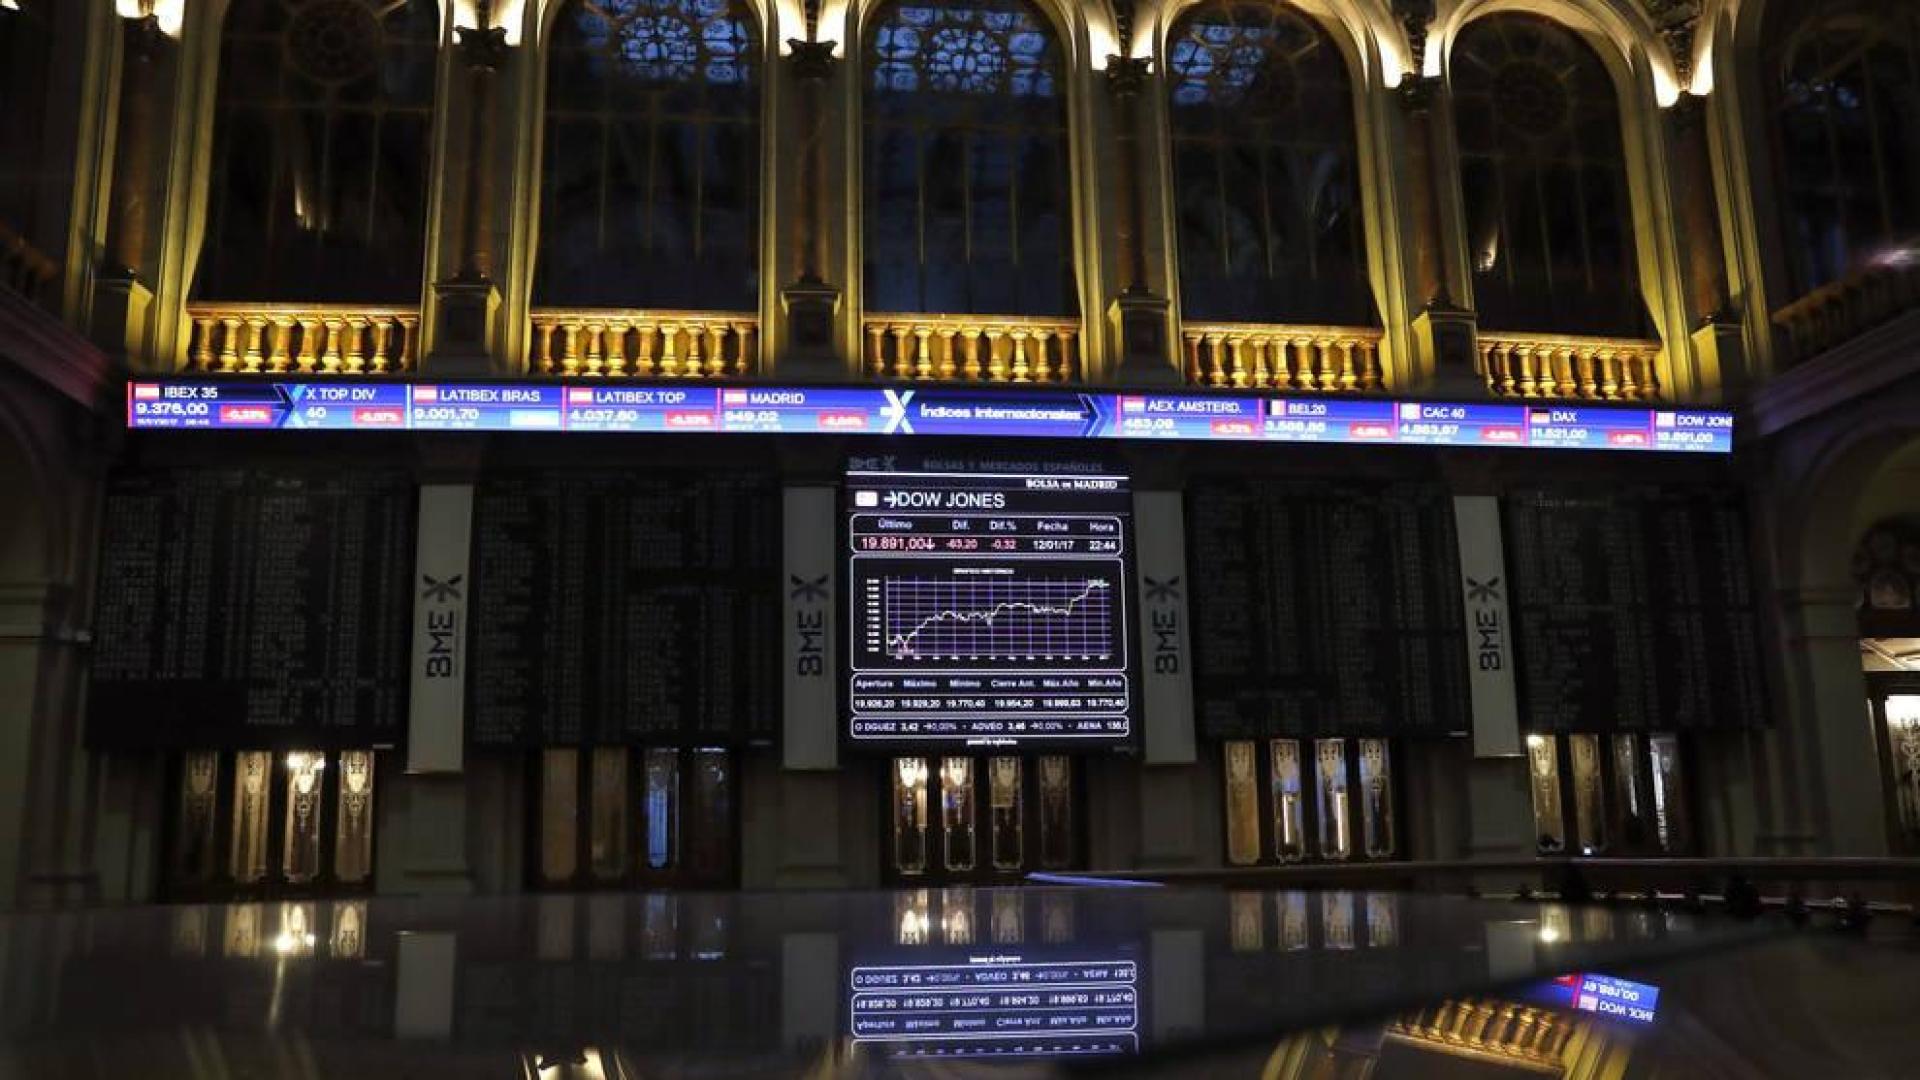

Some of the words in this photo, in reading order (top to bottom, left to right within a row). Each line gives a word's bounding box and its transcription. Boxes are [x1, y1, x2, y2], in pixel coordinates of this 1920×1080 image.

[165, 387, 199, 399] IBEX
[201, 387, 218, 399] 35
[306, 388, 318, 400] X
[320, 388, 350, 400] TOP
[352, 388, 377, 400] DIV
[441, 390, 500, 402] LATIBEX
[502, 391, 541, 402] BRAS
[596, 391, 654, 404] LATIBEX
[656, 392, 686, 404] TOP
[750, 393, 805, 404] MADRID
[1148, 400, 1175, 412] AEX
[306, 407, 327, 418] 40
[1423, 407, 1449, 418] CAC
[1450, 408, 1465, 418] 40
[1552, 412, 1577, 423] DAX
[1677, 415, 1706, 426] DOW
[1025, 479, 1060, 489] BOLSA
[1074, 480, 1118, 489] MADRID
[898, 491, 942, 508] DOW
[946, 491, 1006, 509] JONES
[1037, 521, 1069, 532] Fecha
[1089, 523, 1115, 532] Hora
[861, 537, 926, 552] 19.891,00
[1033, 540, 1075, 551] 12/01/17
[1089, 541, 1116, 551] 22:44
[426, 610, 455, 678] BME
[797, 610, 823, 676] BME
[1152, 609, 1179, 674] BME
[1476, 609, 1501, 671] BME
[855, 679, 893, 690] Apertura
